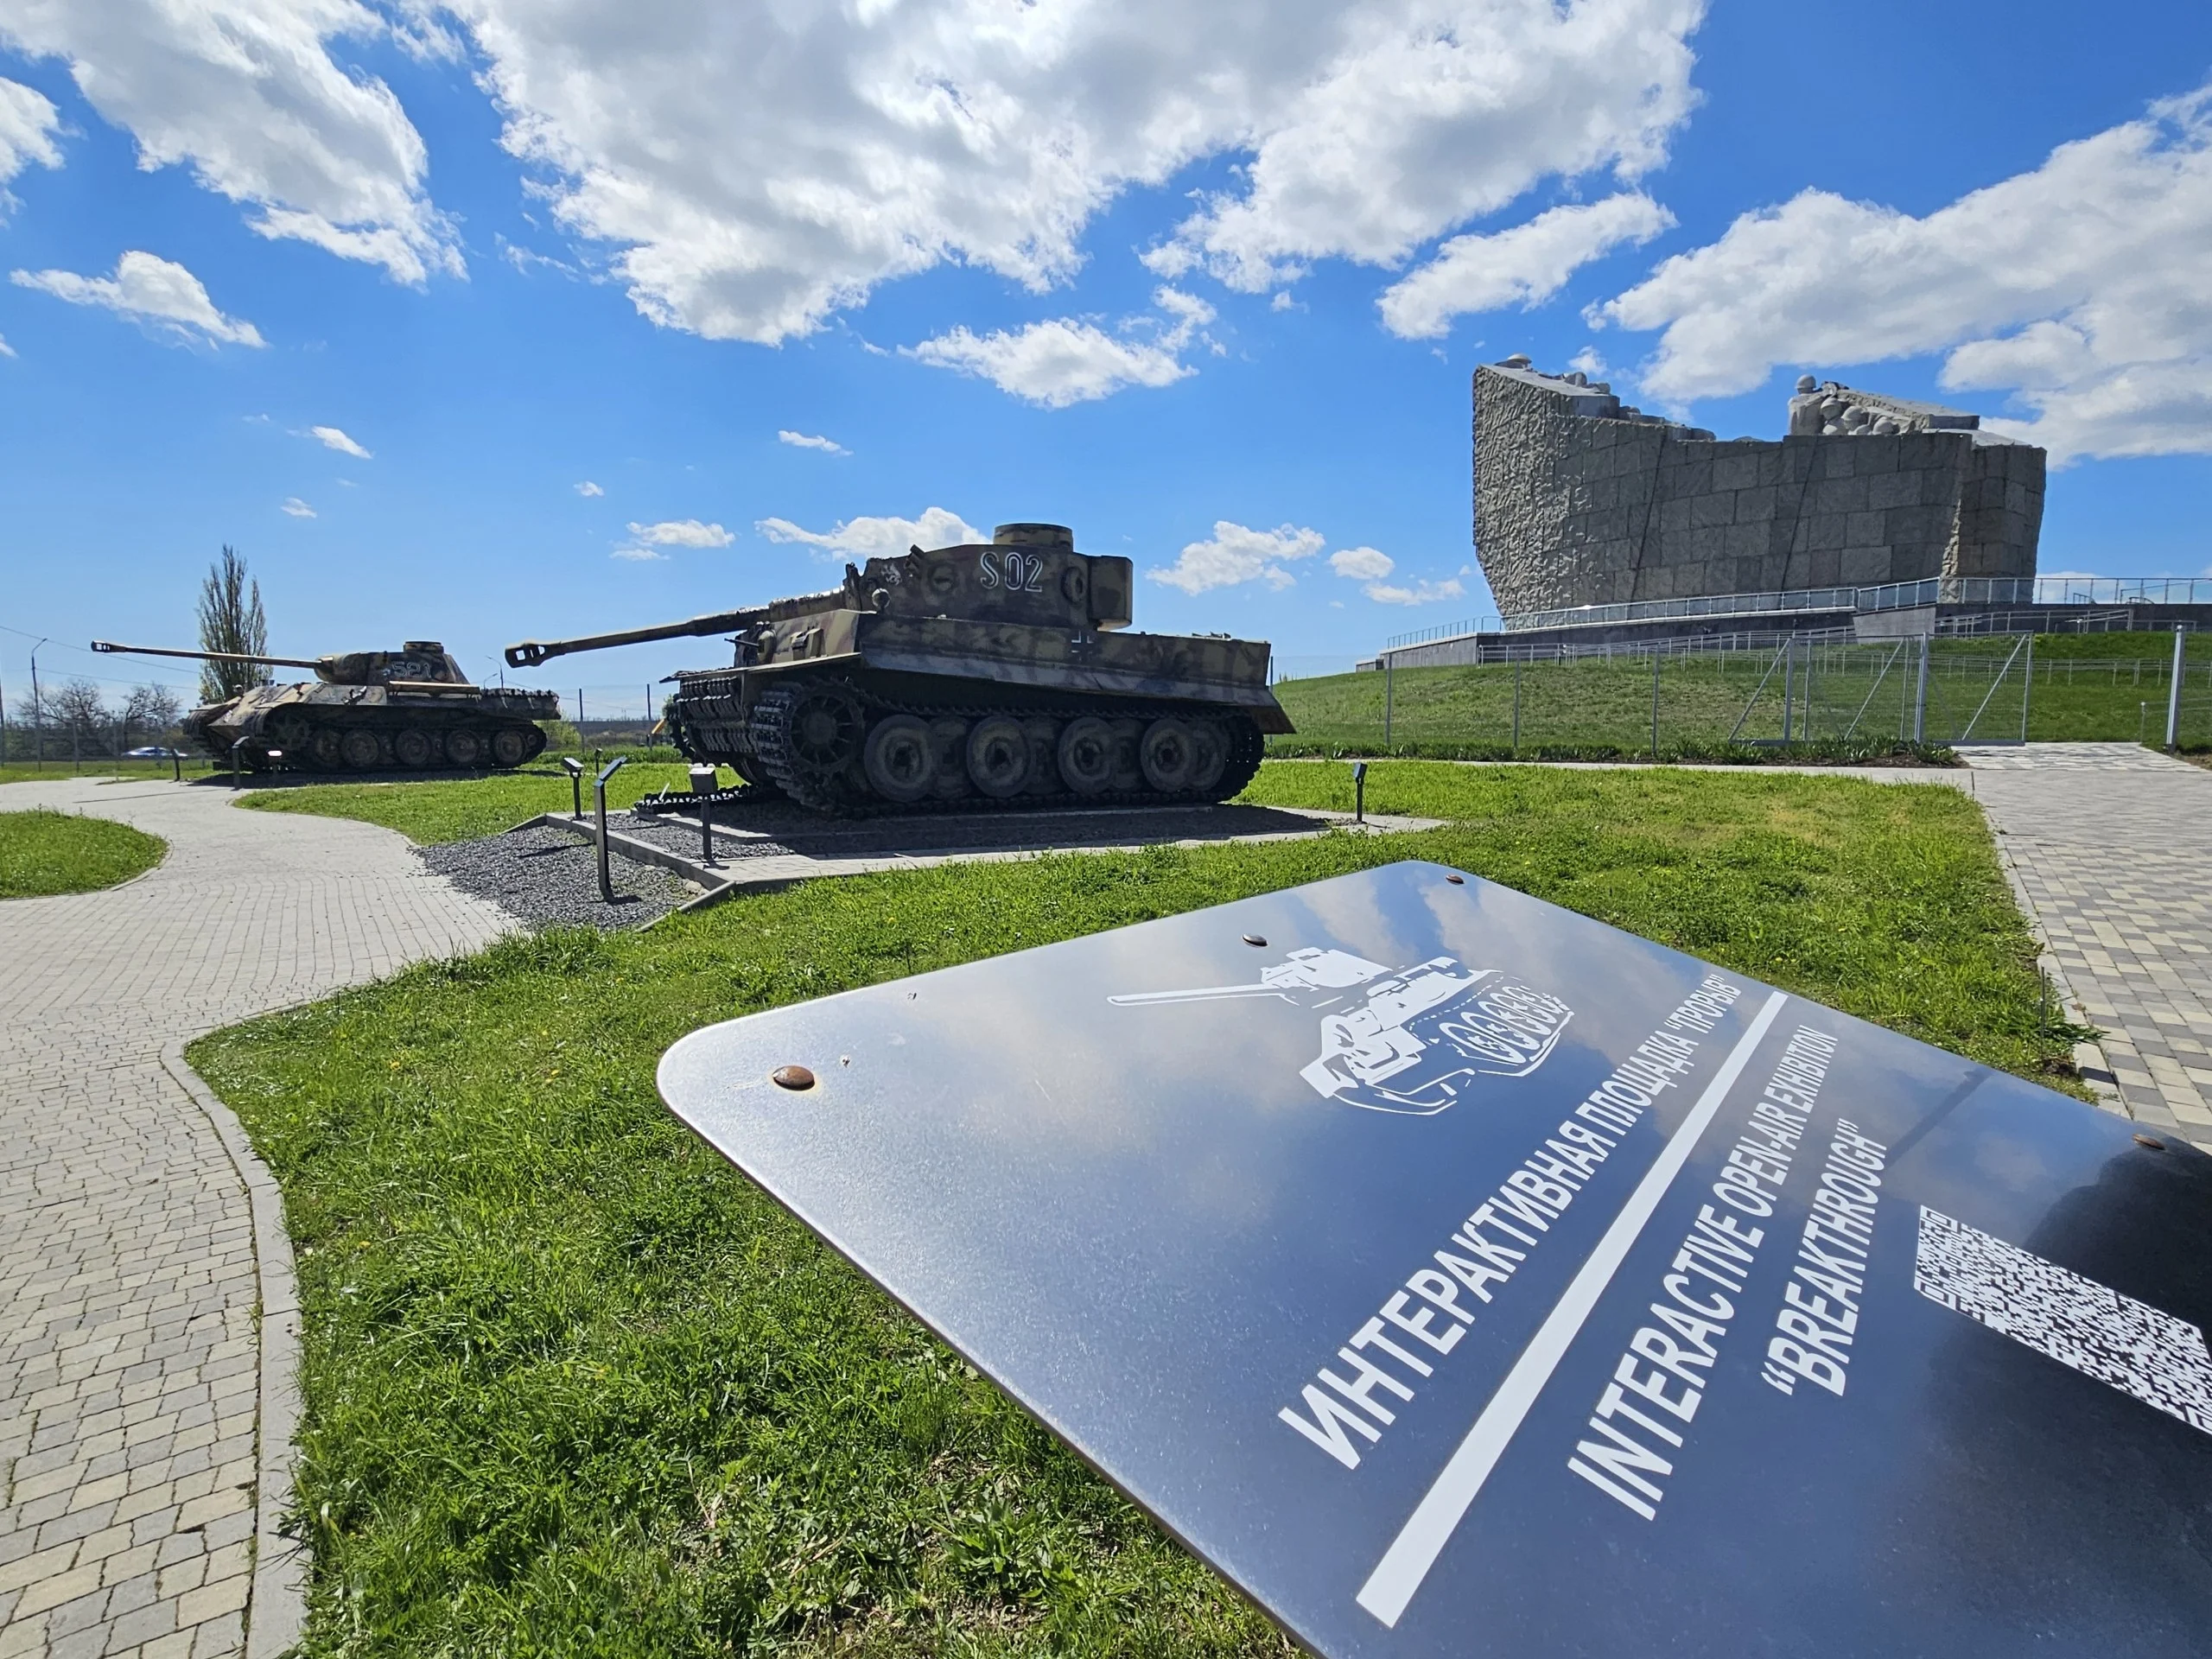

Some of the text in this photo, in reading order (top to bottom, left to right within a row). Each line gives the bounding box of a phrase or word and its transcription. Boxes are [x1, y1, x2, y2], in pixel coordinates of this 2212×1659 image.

[391, 660, 431, 678] 521
[1277, 1120, 1618, 1471] ИНТЕРАКТИВНАЯ
[1574, 1030, 1700, 1136] ПЛОЩАДКА
[1567, 1024, 1839, 1522] INTERACTIVE OPEN-AIR EXHIBITION
[1760, 1117, 1888, 1397] “BREAKTHROUGH”
